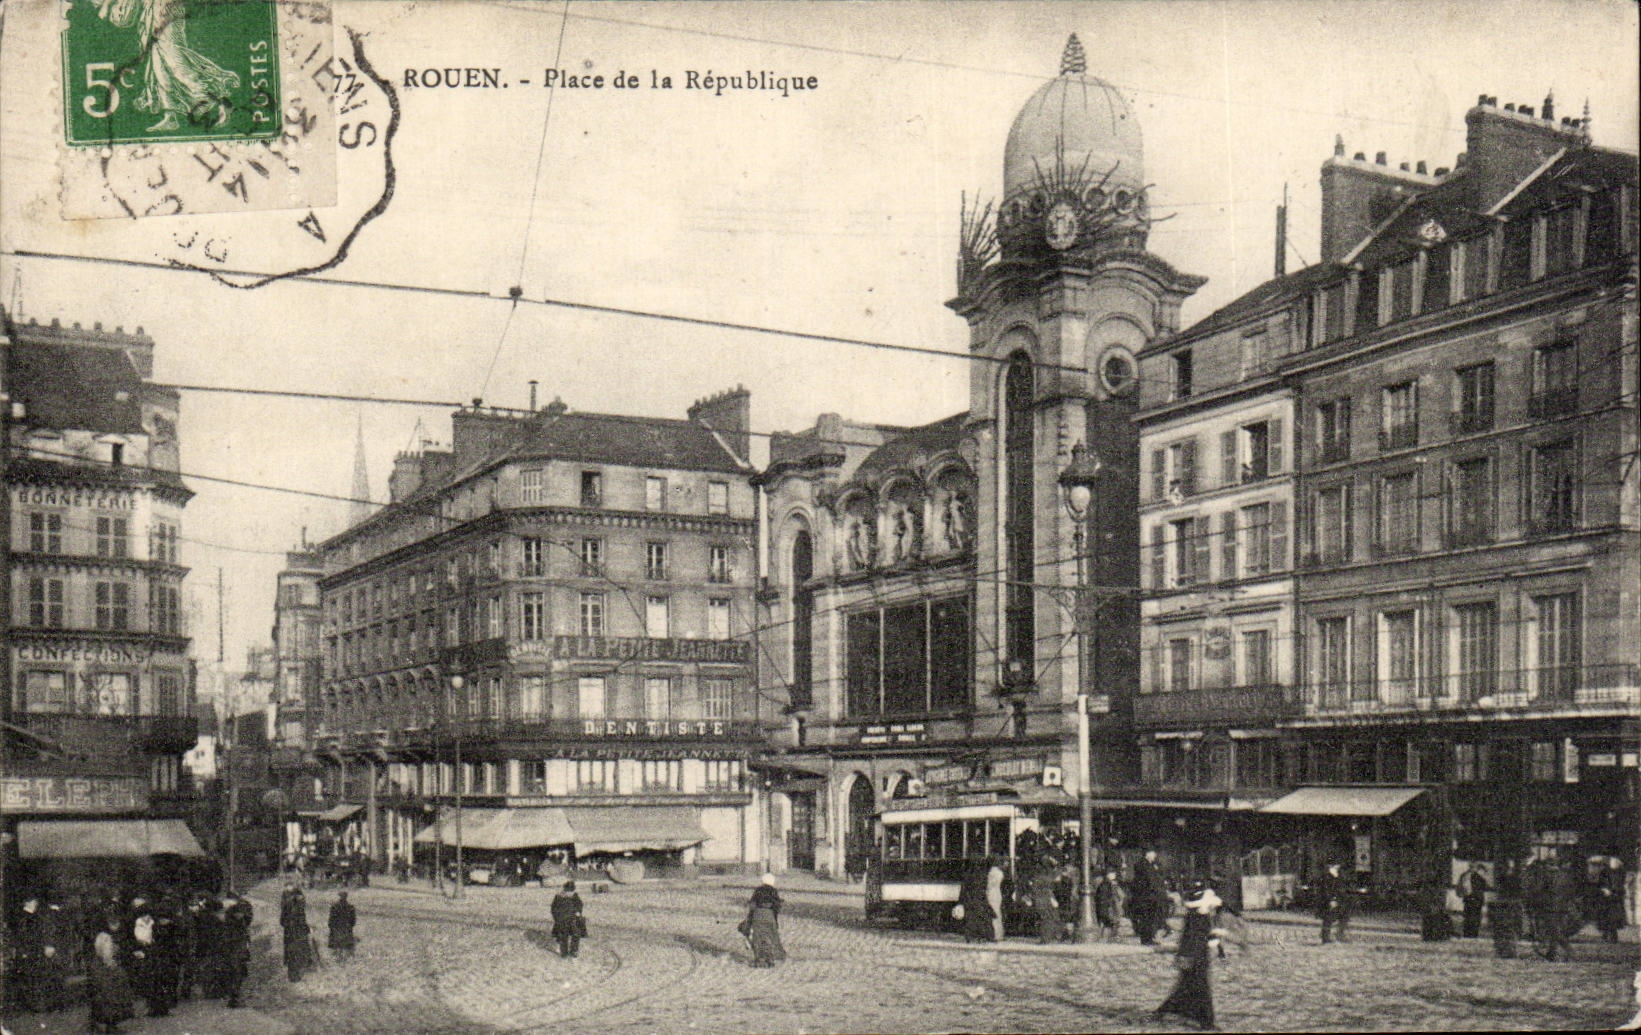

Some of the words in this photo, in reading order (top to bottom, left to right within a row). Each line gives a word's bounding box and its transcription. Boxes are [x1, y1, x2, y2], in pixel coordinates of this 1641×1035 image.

[249, 40, 270, 122] POSTES
[18, 491, 136, 510] BONNETERIE
[584, 720, 724, 736] DENTISTE
